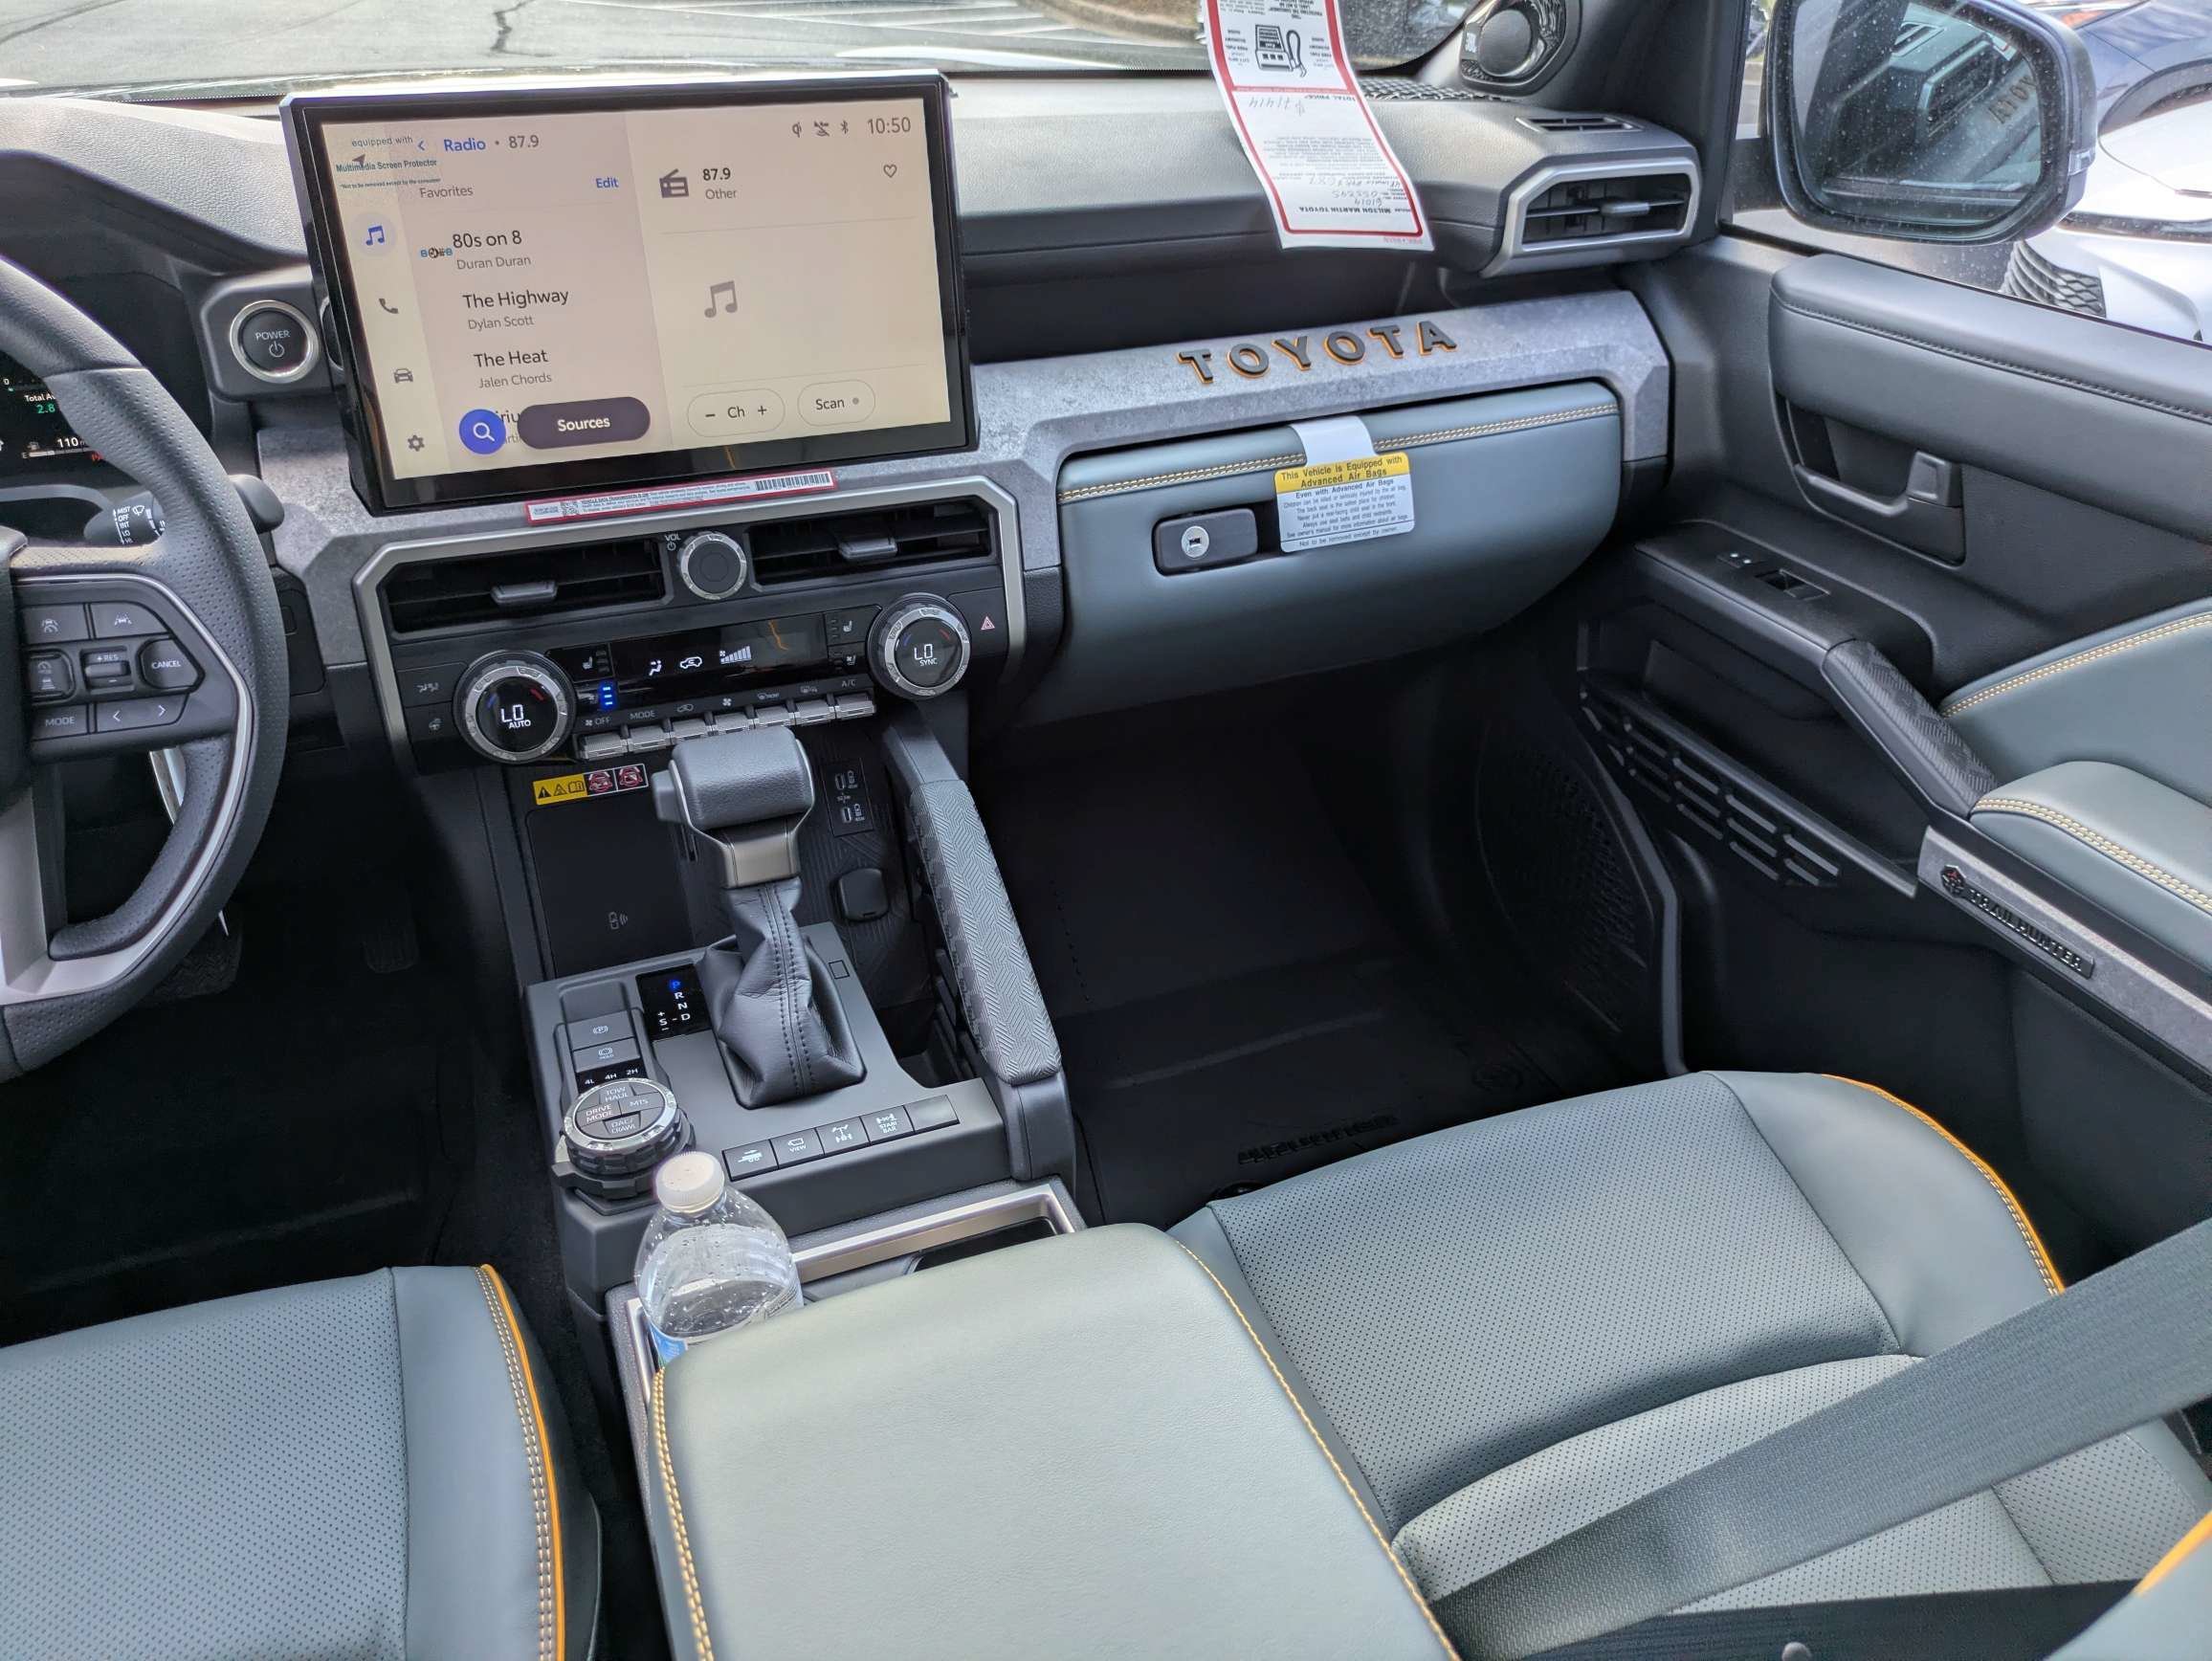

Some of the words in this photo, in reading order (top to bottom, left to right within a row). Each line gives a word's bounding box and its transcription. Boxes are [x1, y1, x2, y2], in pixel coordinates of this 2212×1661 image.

[867, 117, 912, 135] 10:50
[352, 138, 393, 147] equipped
[395, 136, 413, 144] with
[444, 137, 486, 152] Radio
[508, 135, 540, 148] 87.9
[377, 161, 403, 170] Screen
[403, 159, 437, 168] Protector
[702, 166, 731, 182] 87.9
[595, 176, 619, 189] Edit
[419, 185, 474, 199] Favorites
[705, 188, 738, 201] Other
[453, 233, 482, 249] 80s
[486, 234, 508, 247] on
[512, 230, 522, 246] 8
[456, 257, 494, 271] Duran
[497, 255, 531, 269] Duran
[463, 293, 494, 309] The
[498, 289, 569, 309] Highway
[468, 317, 502, 331] Dylan
[504, 315, 535, 329] Scott
[254, 329, 290, 342] POWER
[474, 353, 505, 369] The
[509, 348, 548, 366] Heat
[1176, 321, 1457, 384] TOYOTA
[478, 375, 509, 390] Jalen
[511, 370, 552, 387] Chords
[24, 393, 45, 402] Total
[815, 397, 845, 411] Scan
[36, 403, 55, 413] 2.8
[727, 406, 745, 420] Ch
[557, 416, 610, 432] Sources
[57, 436, 78, 448] 110
[1281, 472, 1299, 481] This
[1303, 466, 1332, 476] Vehicle
[1346, 459, 1382, 472] Equipped
[1386, 456, 1403, 465] with
[1300, 476, 1343, 488] Advanced
[1365, 468, 1387, 478] Bags
[1295, 490, 1313, 498] Even
[1331, 484, 1362, 494] Advanced
[1378, 478, 1394, 487] Bags
[117, 506, 131, 515] MIST
[118, 514, 129, 522] OFF
[665, 533, 681, 542] VOL
[914, 643, 934, 661] LO
[151, 660, 182, 670] CANCEL
[919, 657, 938, 667] SYNC
[500, 703, 524, 723] LO
[630, 710, 655, 720] MODE
[45, 716, 76, 727] MODE
[508, 719, 532, 729] AUTO
[595, 717, 611, 726] OFF
[674, 991, 685, 1000] R
[677, 1002, 688, 1010] N
[606, 1086, 627, 1096] TOW
[605, 1093, 629, 1103] HAUL
[629, 1098, 649, 1107] MTS
[586, 1103, 612, 1117] DRIVE
[586, 1111, 614, 1123] MODE
[611, 1124, 636, 1135] CRAWL
[788, 1144, 807, 1153] VIEW
